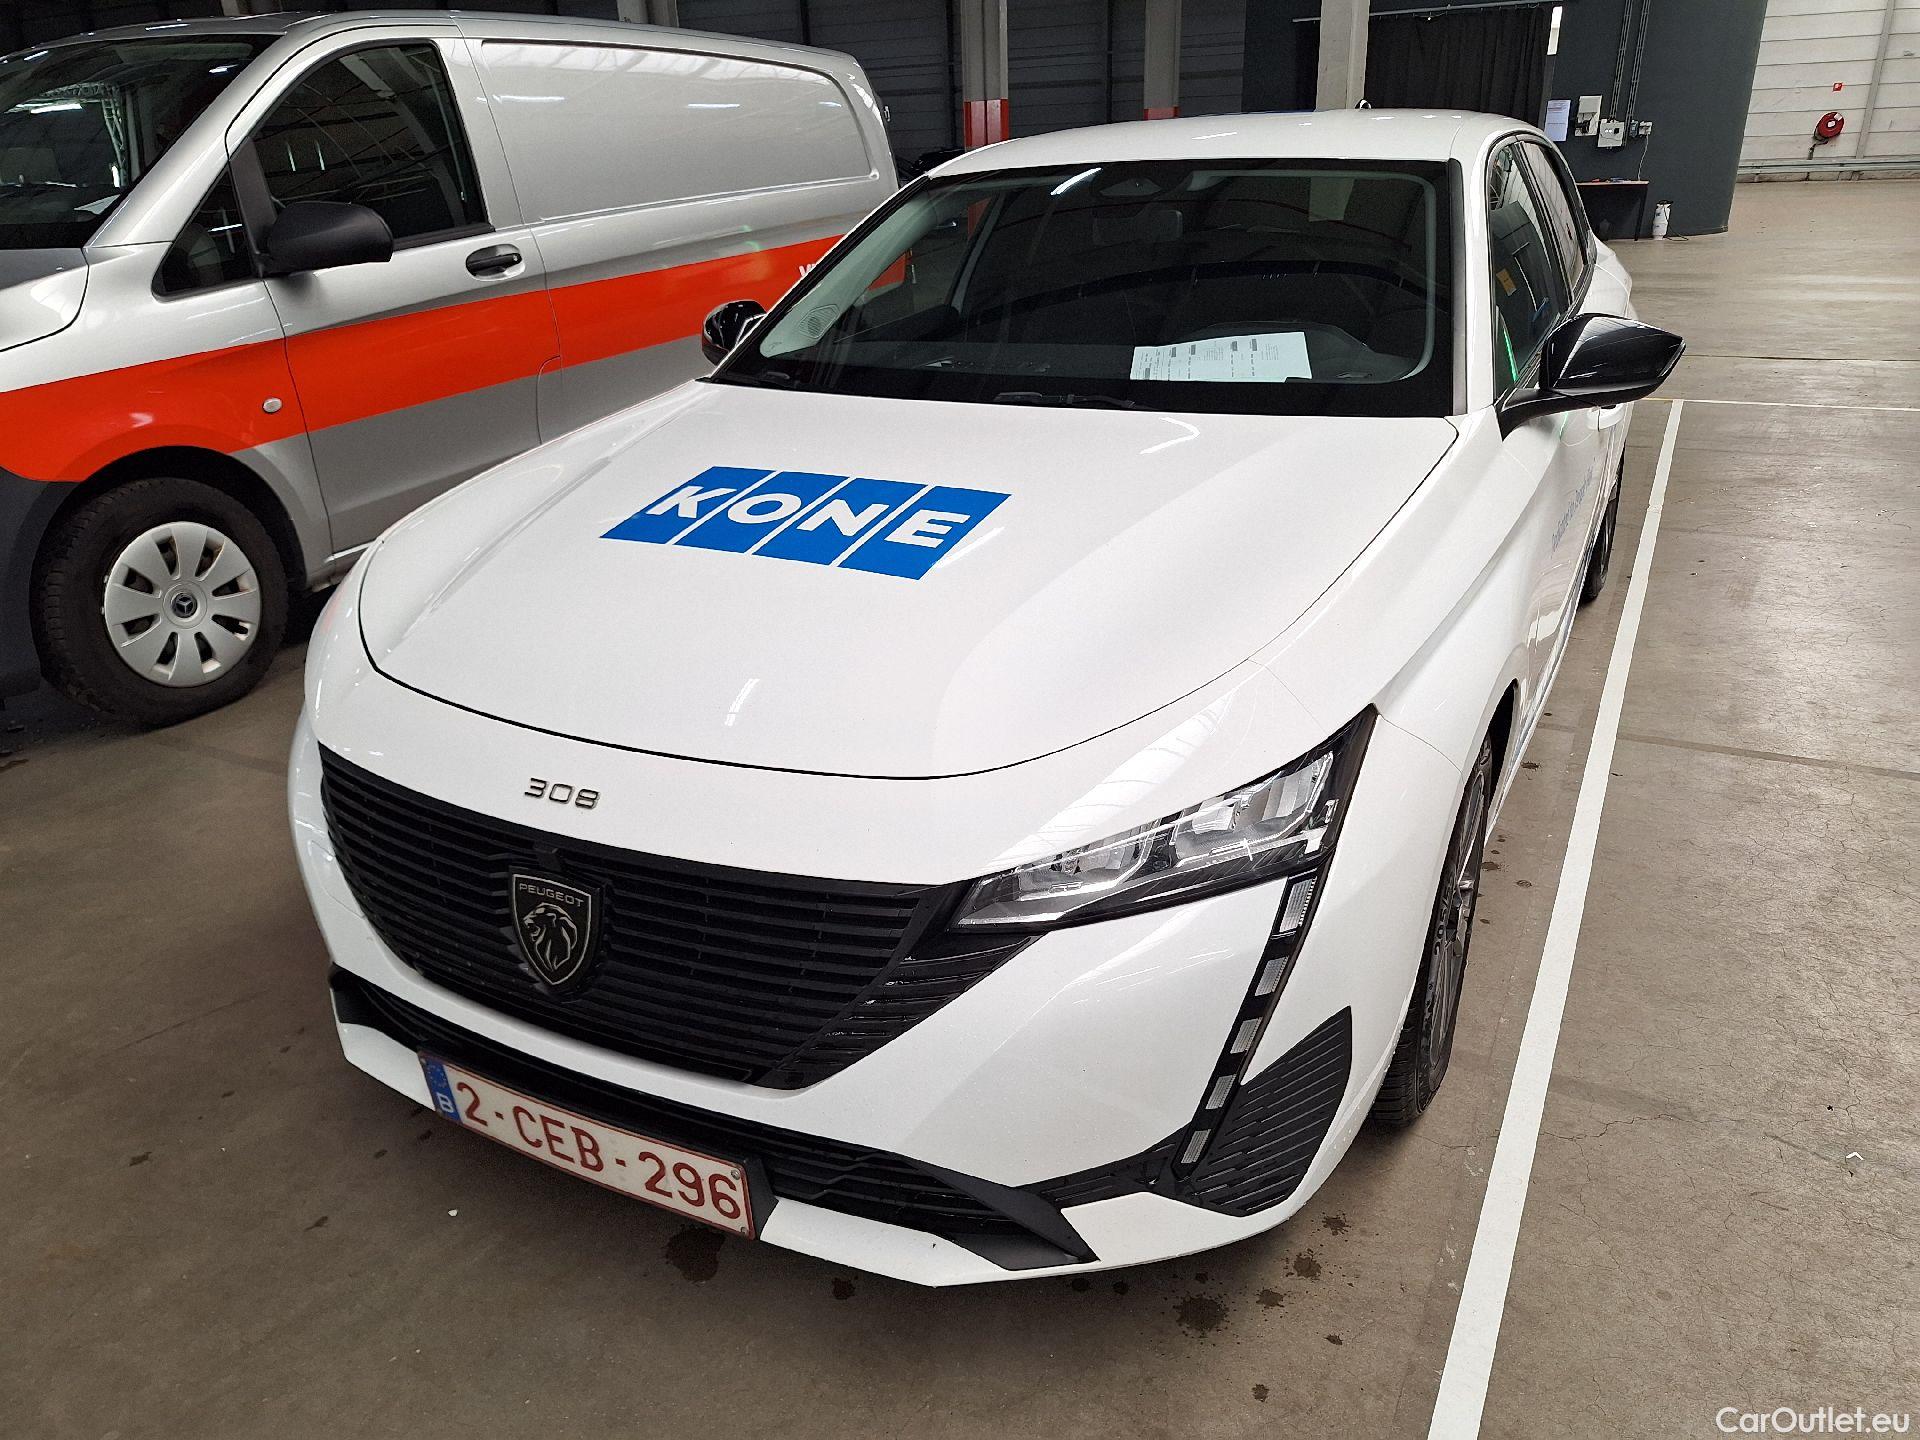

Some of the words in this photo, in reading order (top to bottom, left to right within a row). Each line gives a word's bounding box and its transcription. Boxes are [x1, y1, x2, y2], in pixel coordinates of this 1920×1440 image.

[644, 485, 971, 549] KONE
[524, 777, 600, 810] 308
[519, 882, 584, 908] PEUGEOT
[436, 1092, 454, 1113] B
[456, 1081, 741, 1220] 2-CEB-296
